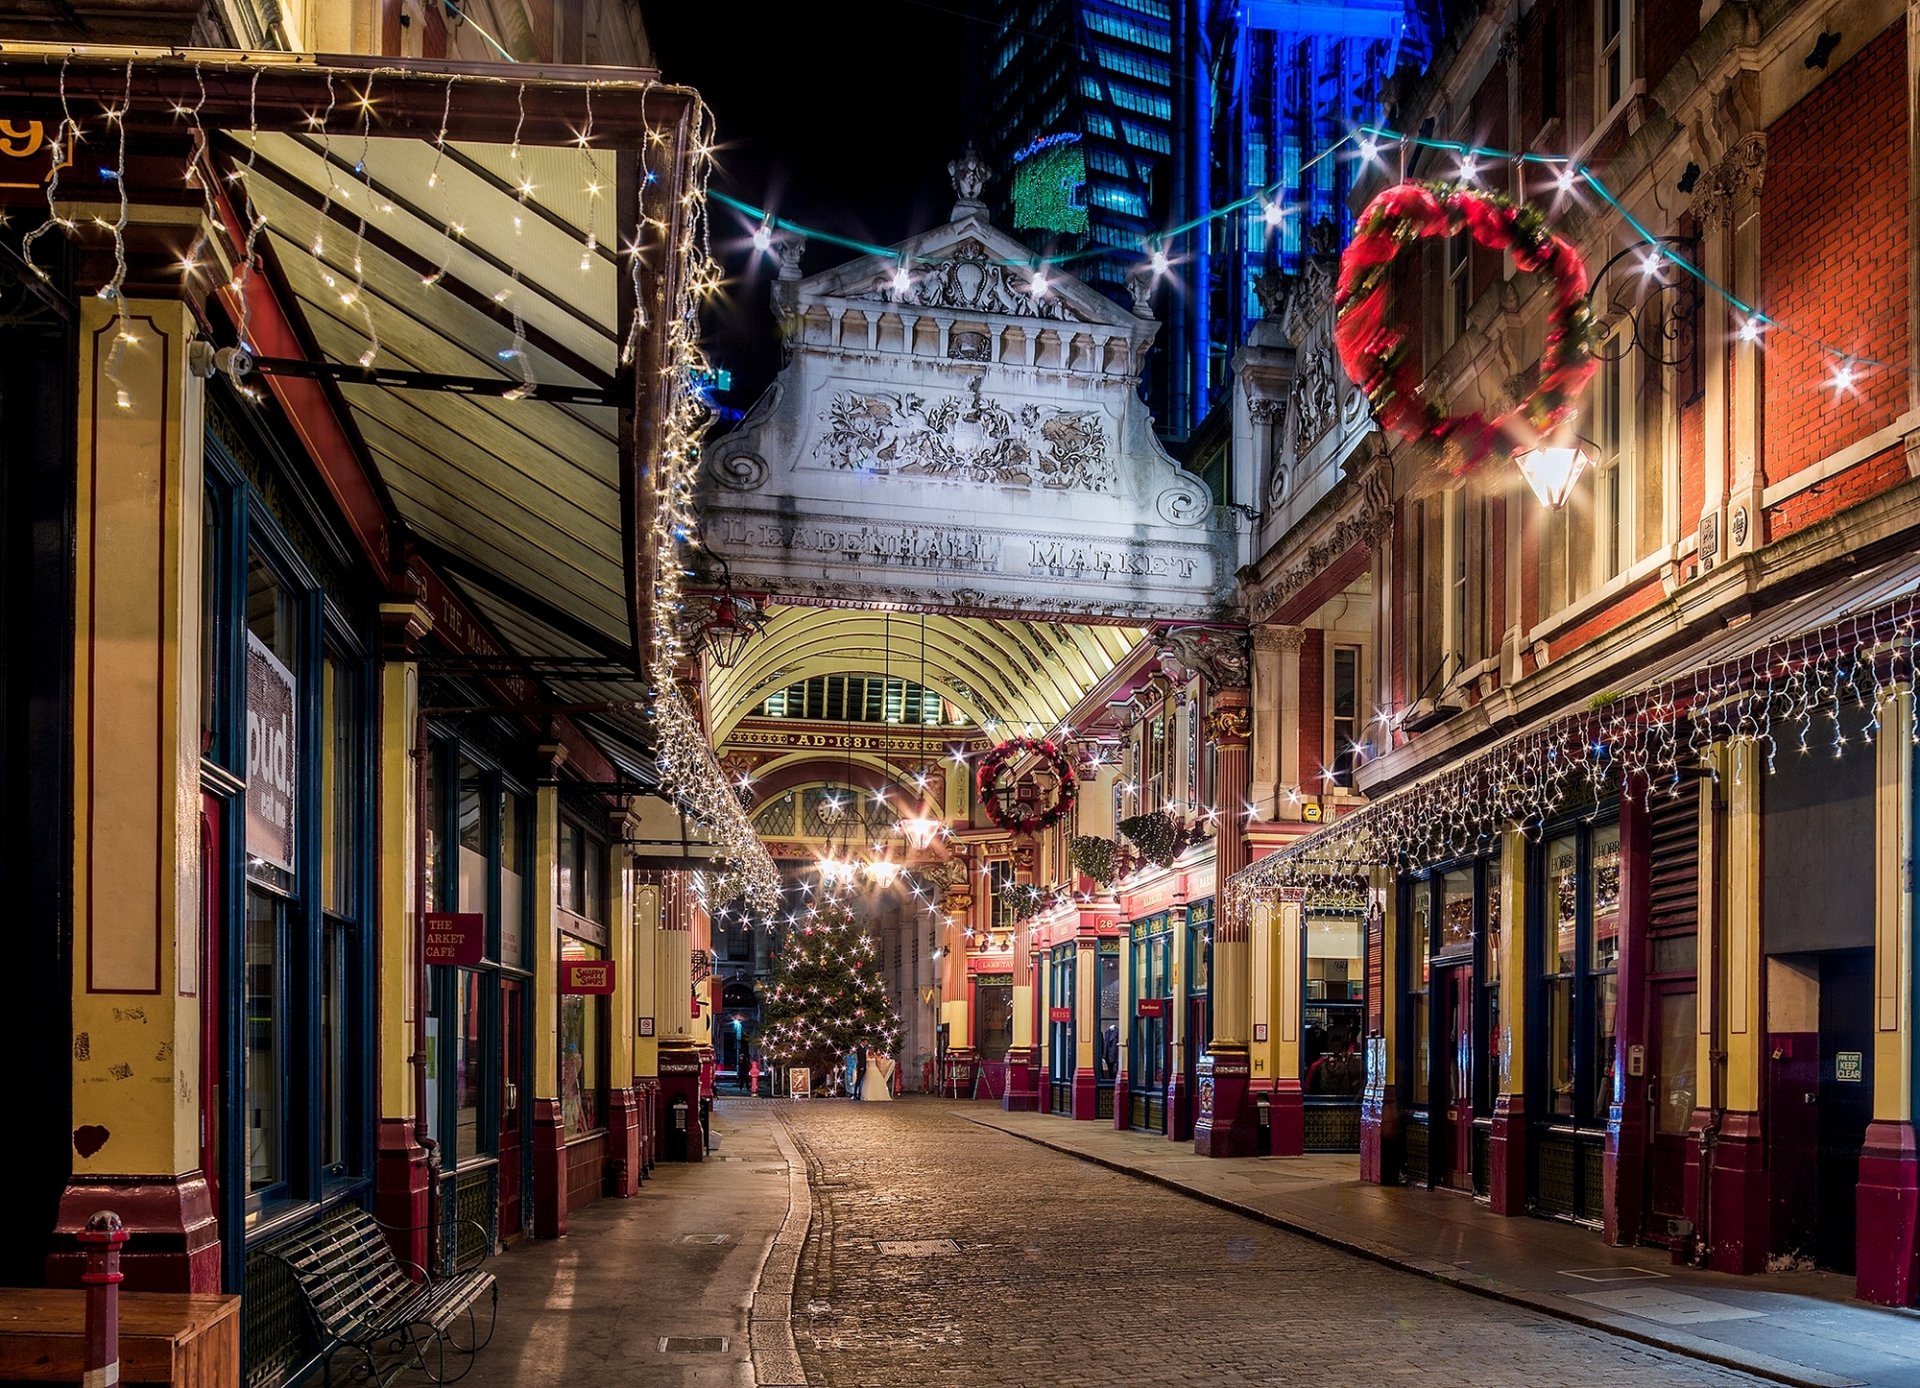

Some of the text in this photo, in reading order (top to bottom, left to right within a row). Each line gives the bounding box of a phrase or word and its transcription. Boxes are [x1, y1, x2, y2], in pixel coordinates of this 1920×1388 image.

[723, 517, 1198, 578] LEADENHALL MARKET
[442, 597, 463, 637] THE
[836, 736, 871, 748] 1881
[429, 920, 452, 930] THE
[1100, 920, 1114, 928] 26
[426, 933, 465, 944] ARKET
[425, 945, 455, 957] CAFÉ
[576, 968, 604, 978] SNAPPY
[580, 976, 604, 986] SNAPS
[1840, 1061, 1858, 1070] KEEP
[1838, 1070, 1861, 1079] CLEAR
